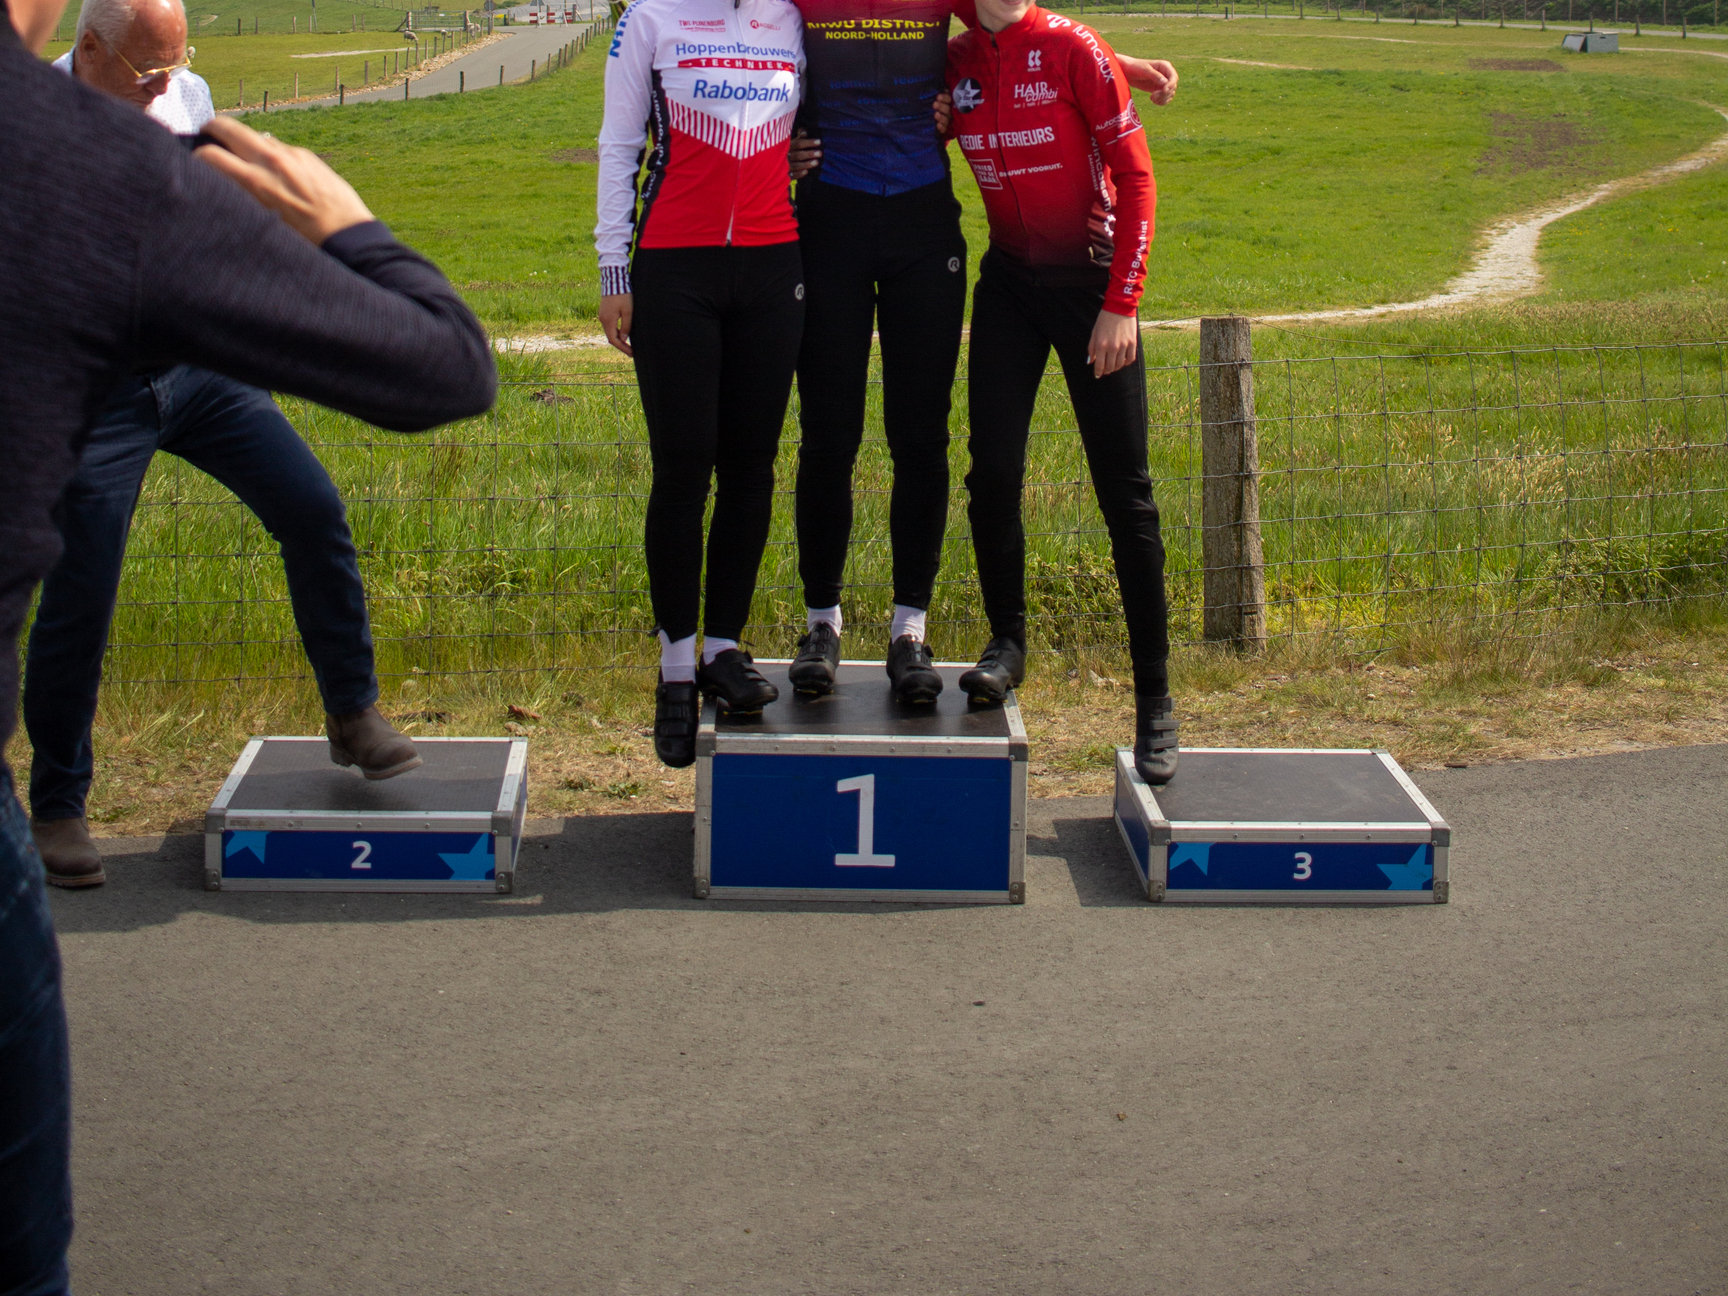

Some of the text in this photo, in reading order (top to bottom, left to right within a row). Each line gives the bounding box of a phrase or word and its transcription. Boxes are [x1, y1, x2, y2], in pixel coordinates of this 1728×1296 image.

[825, 31, 925, 40] NOORD-HOLLAND
[676, 42, 796, 58] Hoppenbrouwers
[1072, 24, 1115, 84] lumalux
[700, 58, 784, 69] TECHNIEK
[693, 79, 790, 102] Rabobank
[1014, 81, 1048, 98] HAIR
[1025, 87, 1059, 102] combi
[988, 126, 1055, 149] INTERIEURS
[1028, 163, 1063, 174] VOORUIT.
[835, 773, 896, 867] 1
[351, 840, 372, 869] 2
[1293, 851, 1312, 880] 3
